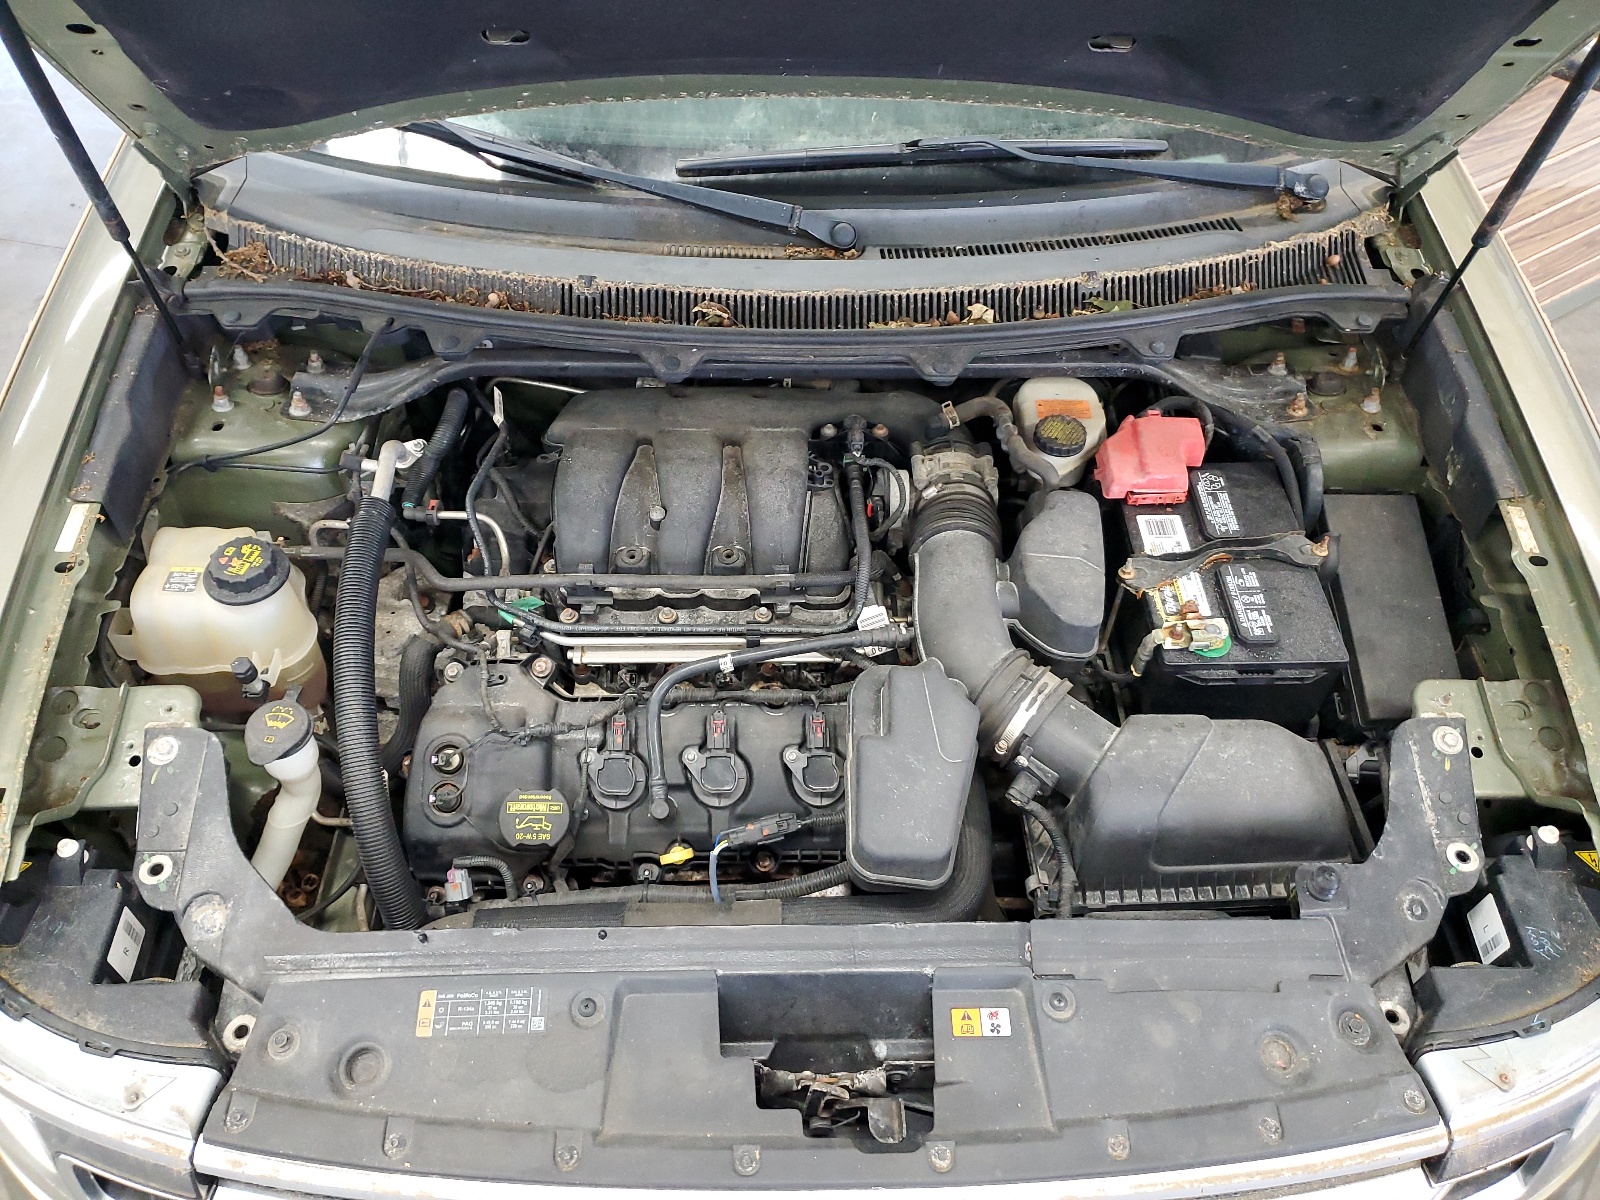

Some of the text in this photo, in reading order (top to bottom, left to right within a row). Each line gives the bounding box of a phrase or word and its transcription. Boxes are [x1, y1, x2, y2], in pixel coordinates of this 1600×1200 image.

[1225, 575, 1238, 596] POISON
[1234, 600, 1246, 622] DANGER
[508, 803, 547, 812] Motorcraft
